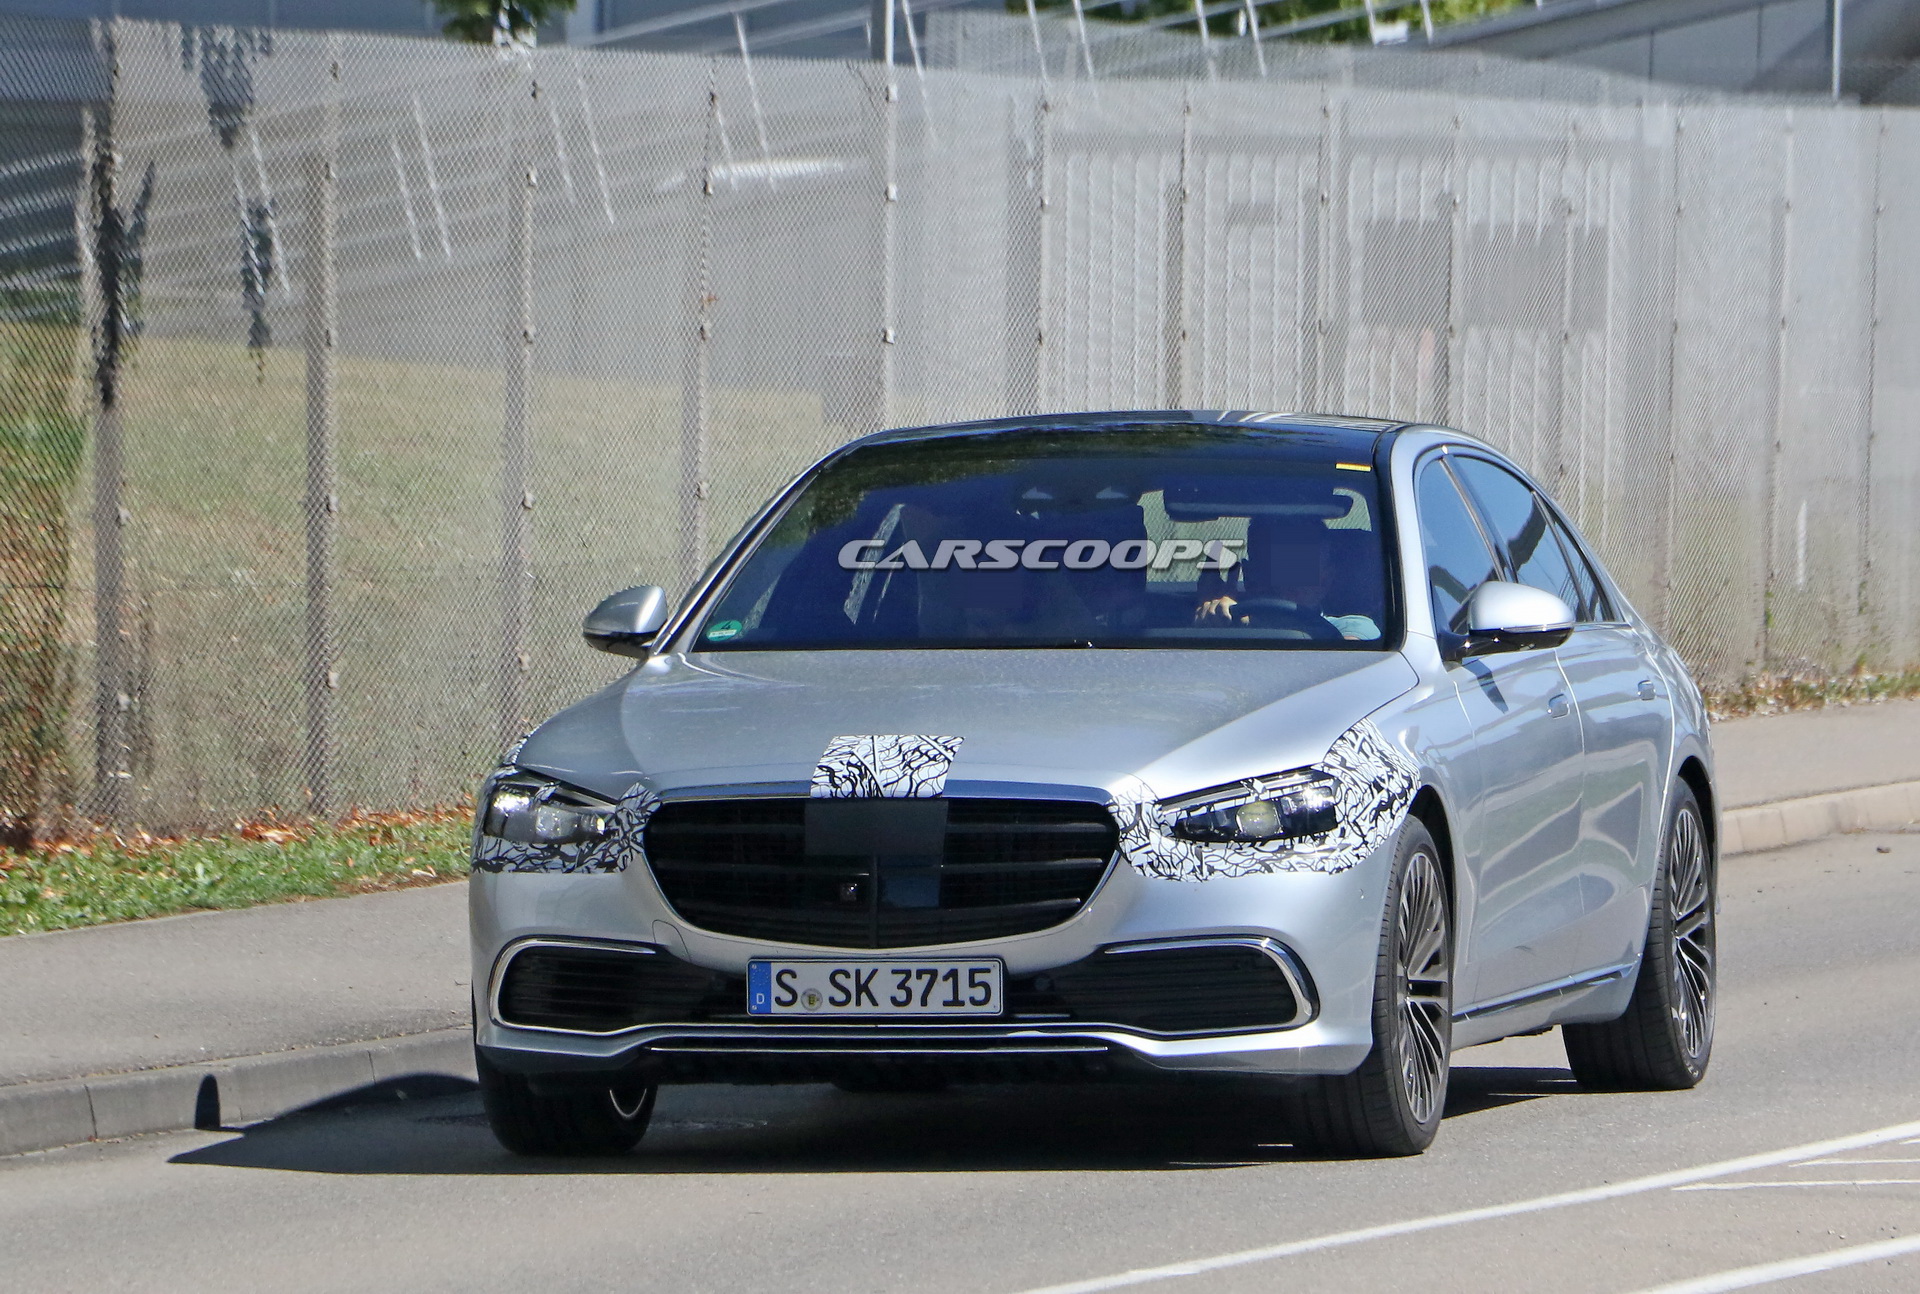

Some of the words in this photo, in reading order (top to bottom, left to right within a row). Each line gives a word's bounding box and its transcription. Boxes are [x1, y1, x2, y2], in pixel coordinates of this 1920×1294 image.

[756, 993, 765, 1004] D
[774, 968, 798, 1007] S
[828, 968, 879, 1007] SK
[890, 968, 992, 1007] 3715
